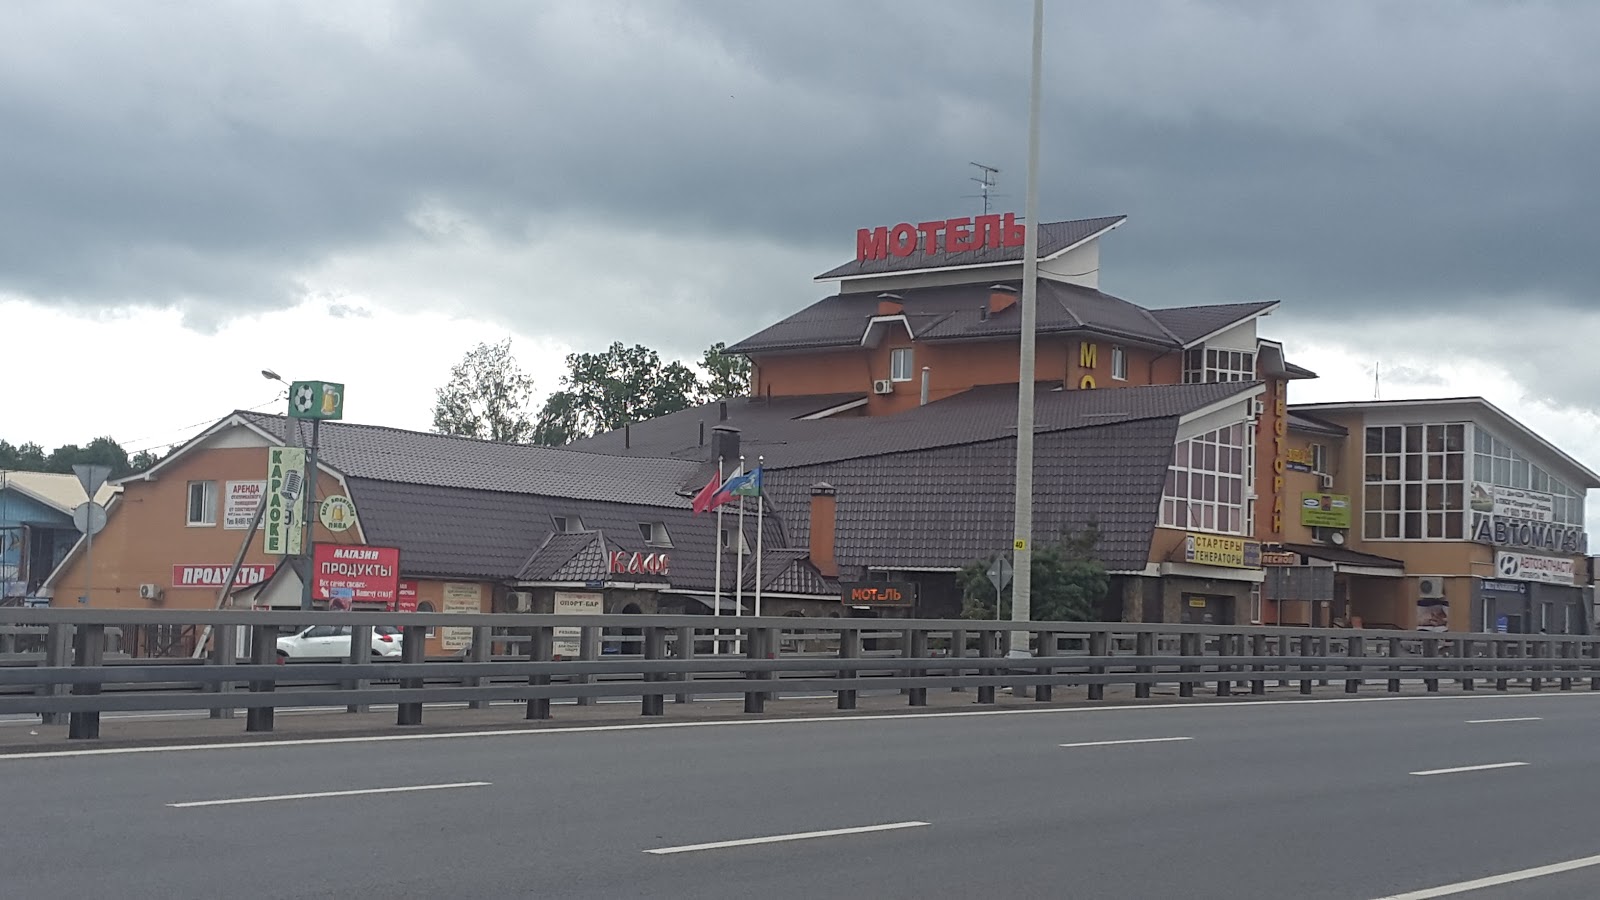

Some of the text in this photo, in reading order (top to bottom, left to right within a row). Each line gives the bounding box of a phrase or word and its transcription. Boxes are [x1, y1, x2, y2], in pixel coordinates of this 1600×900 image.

[857, 213, 1025, 262] МОТЕЛЬ
[1273, 380, 1287, 533] РЕСТОРАН
[232, 484, 260, 494] АРЕНДА
[269, 450, 283, 551] КАРАОКЕ
[1015, 541, 1024, 549] 40
[1196, 536, 1242, 552] СТАРТЕРЫ
[333, 549, 379, 560] МАГАЗИН
[1196, 550, 1242, 565] ГЕНЕРАТОРЫ
[321, 562, 392, 577] ПРОДУКТЫ
[608, 550, 670, 577] КАФЕ
[1520, 556, 1574, 574] АВТОЗАПЧАСТИ
